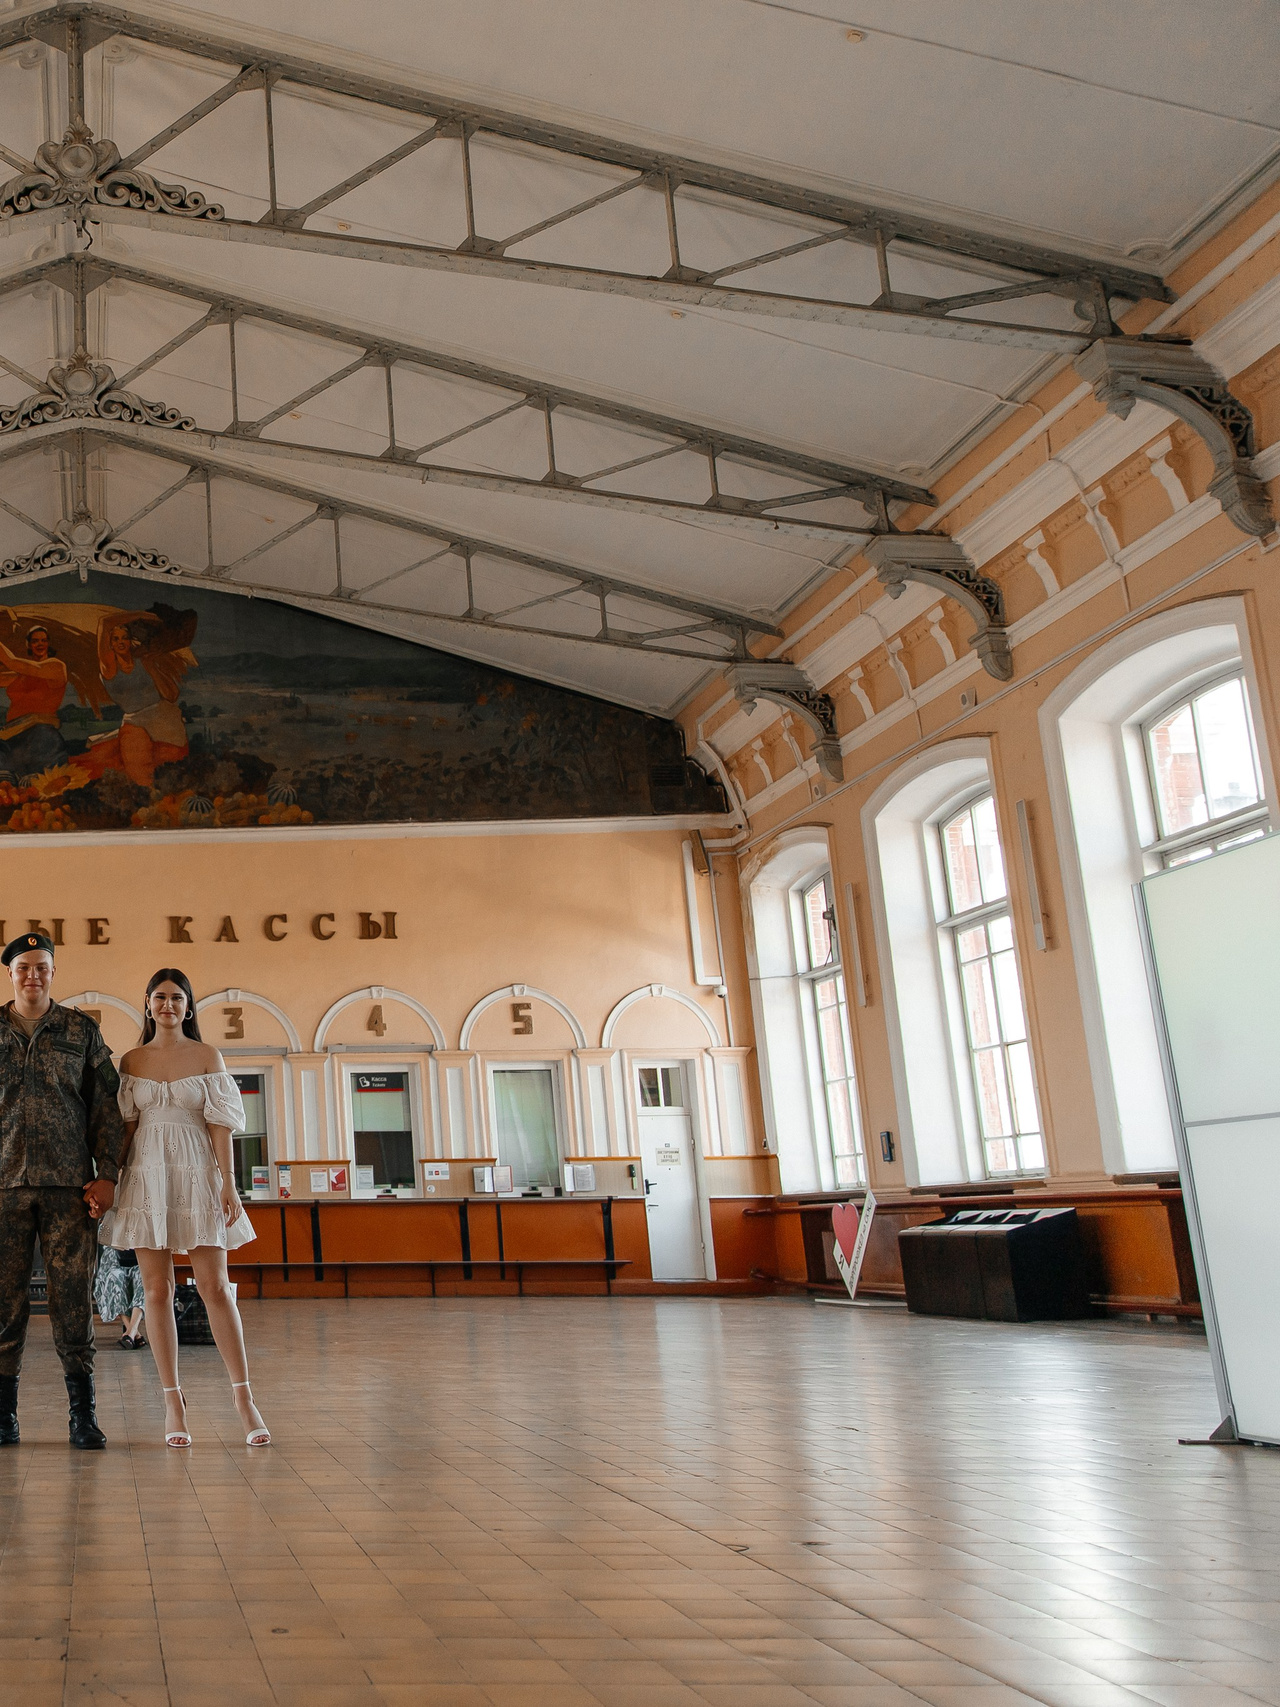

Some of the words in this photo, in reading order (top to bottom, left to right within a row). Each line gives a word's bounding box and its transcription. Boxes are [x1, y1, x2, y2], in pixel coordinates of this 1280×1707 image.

[167, 911, 398, 944] КАССЫ
[222, 1007, 245, 1040] 3
[367, 1004, 387, 1037] 4
[513, 1003, 533, 1035] 5
